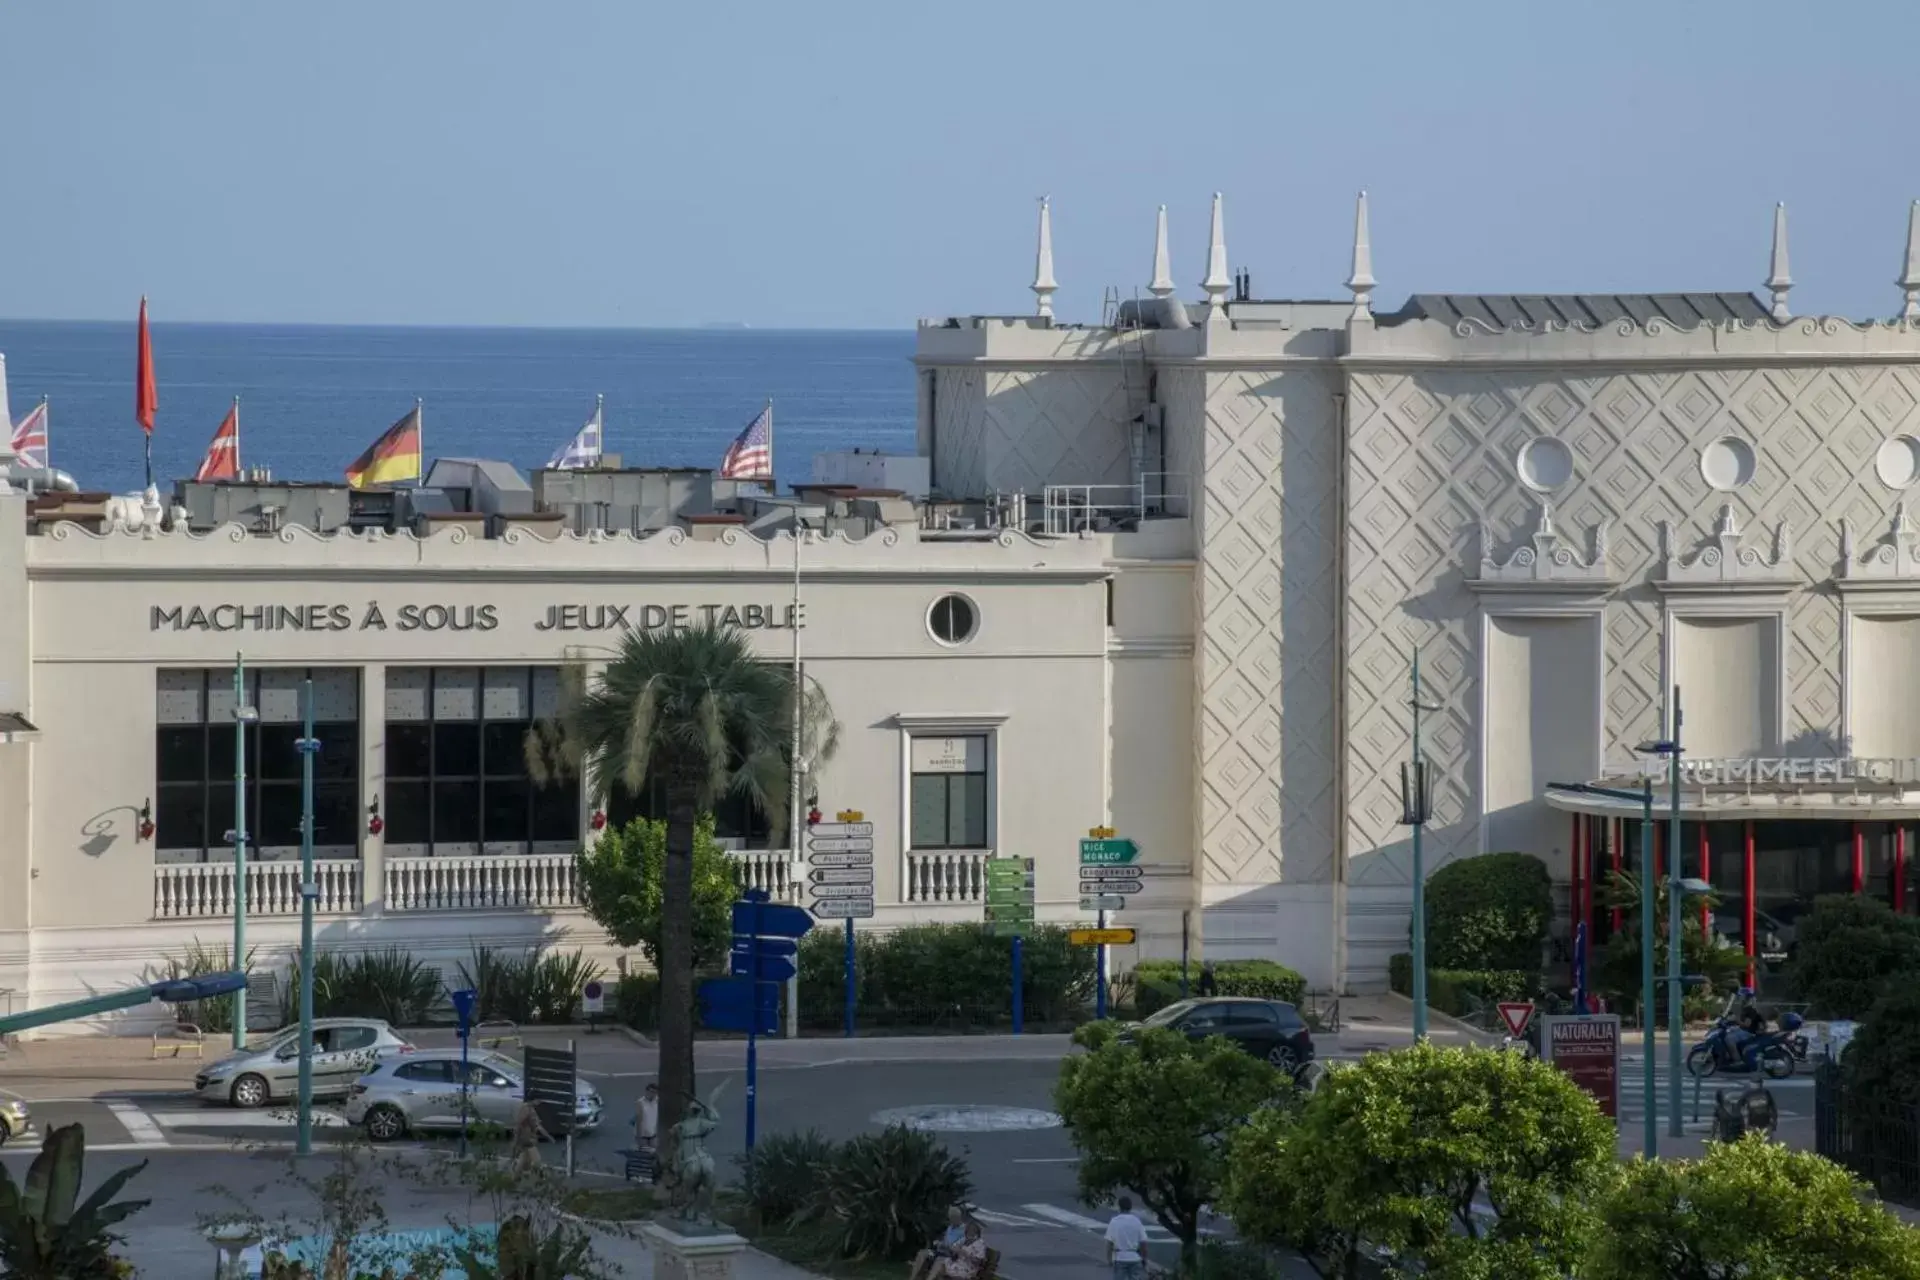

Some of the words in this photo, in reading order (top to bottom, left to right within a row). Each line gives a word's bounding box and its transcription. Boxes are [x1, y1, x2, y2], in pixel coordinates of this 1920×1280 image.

[150, 603, 351, 631] MACHINES
[359, 600, 387, 631] À
[396, 603, 498, 631] SOUS
[534, 604, 631, 630] JEUX
[640, 604, 691, 630] DE
[697, 604, 806, 630] TABLE
[1083, 843, 1105, 851] NICE
[1083, 852, 1121, 860] MONACO
[1553, 1023, 1614, 1040] NATURALIA
